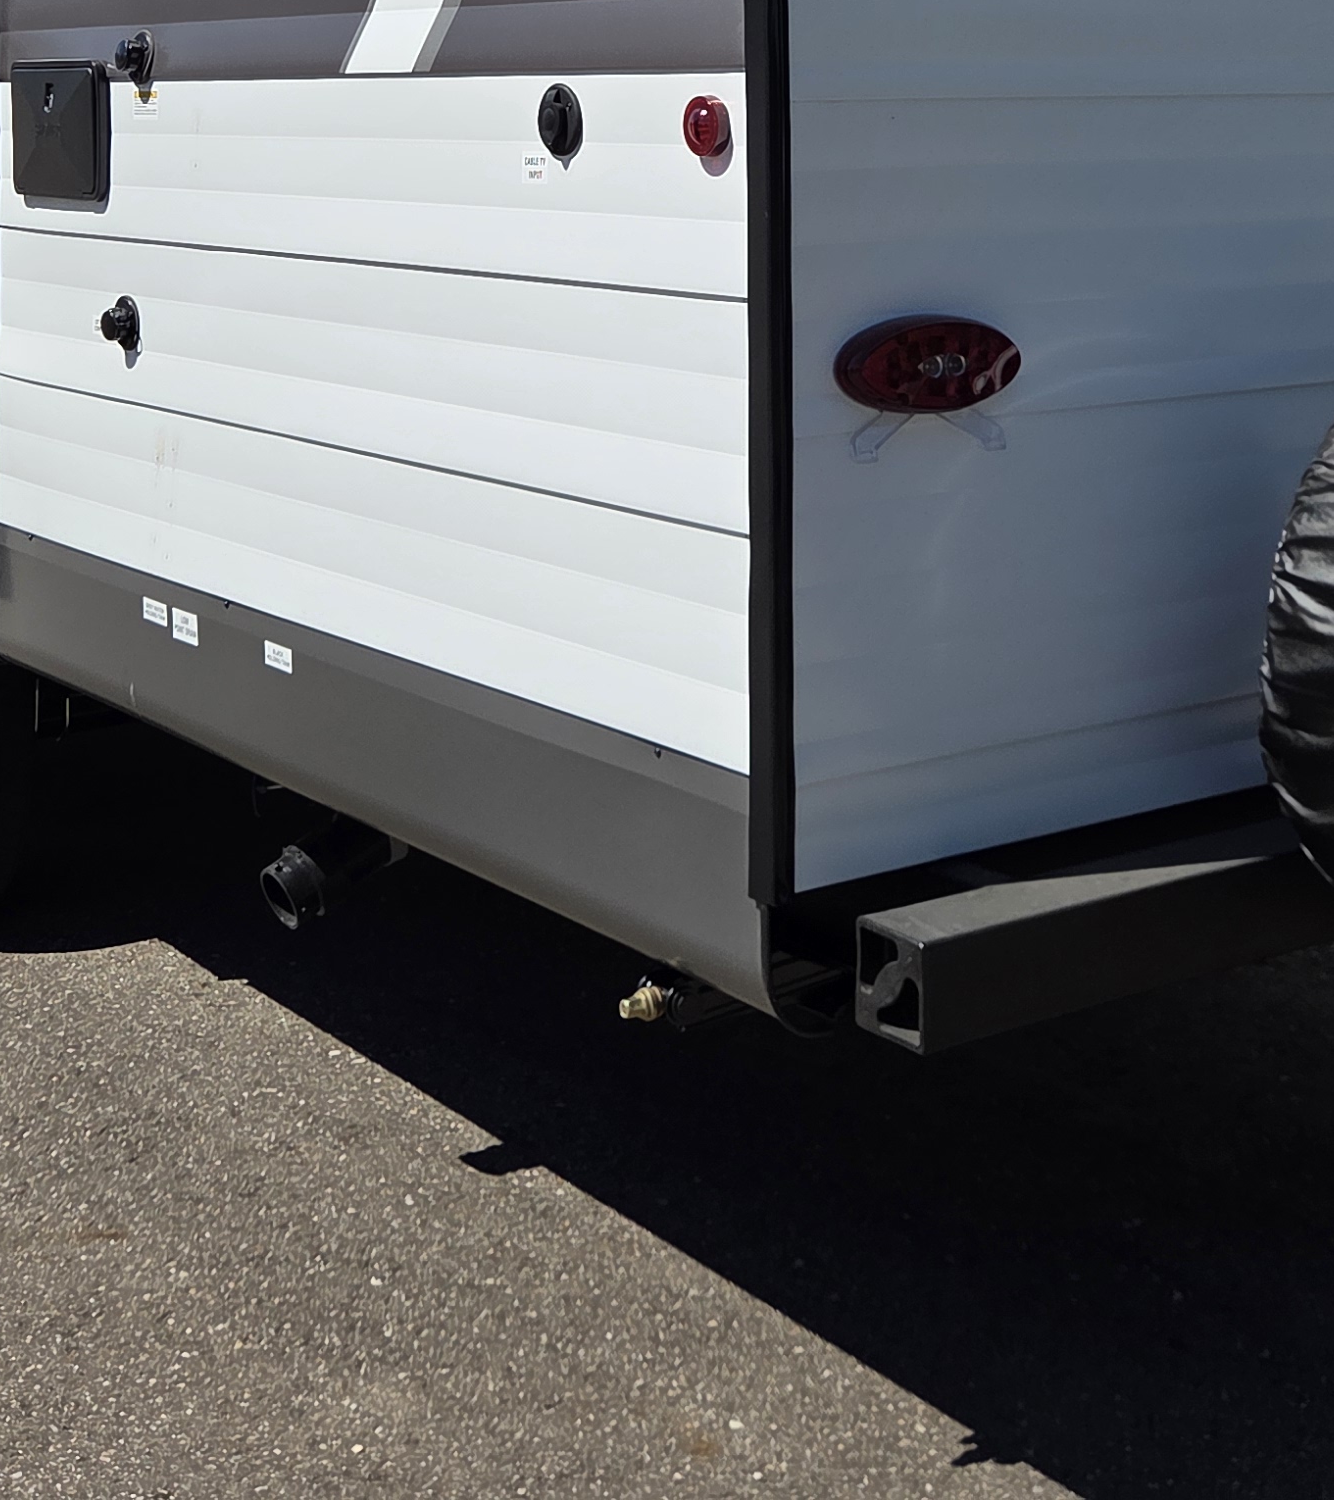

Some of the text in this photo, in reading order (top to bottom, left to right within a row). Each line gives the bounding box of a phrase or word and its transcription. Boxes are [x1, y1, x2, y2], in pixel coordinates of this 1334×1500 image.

[524, 156, 546, 166] CABLE TV
[528, 170, 543, 180] INPUT
